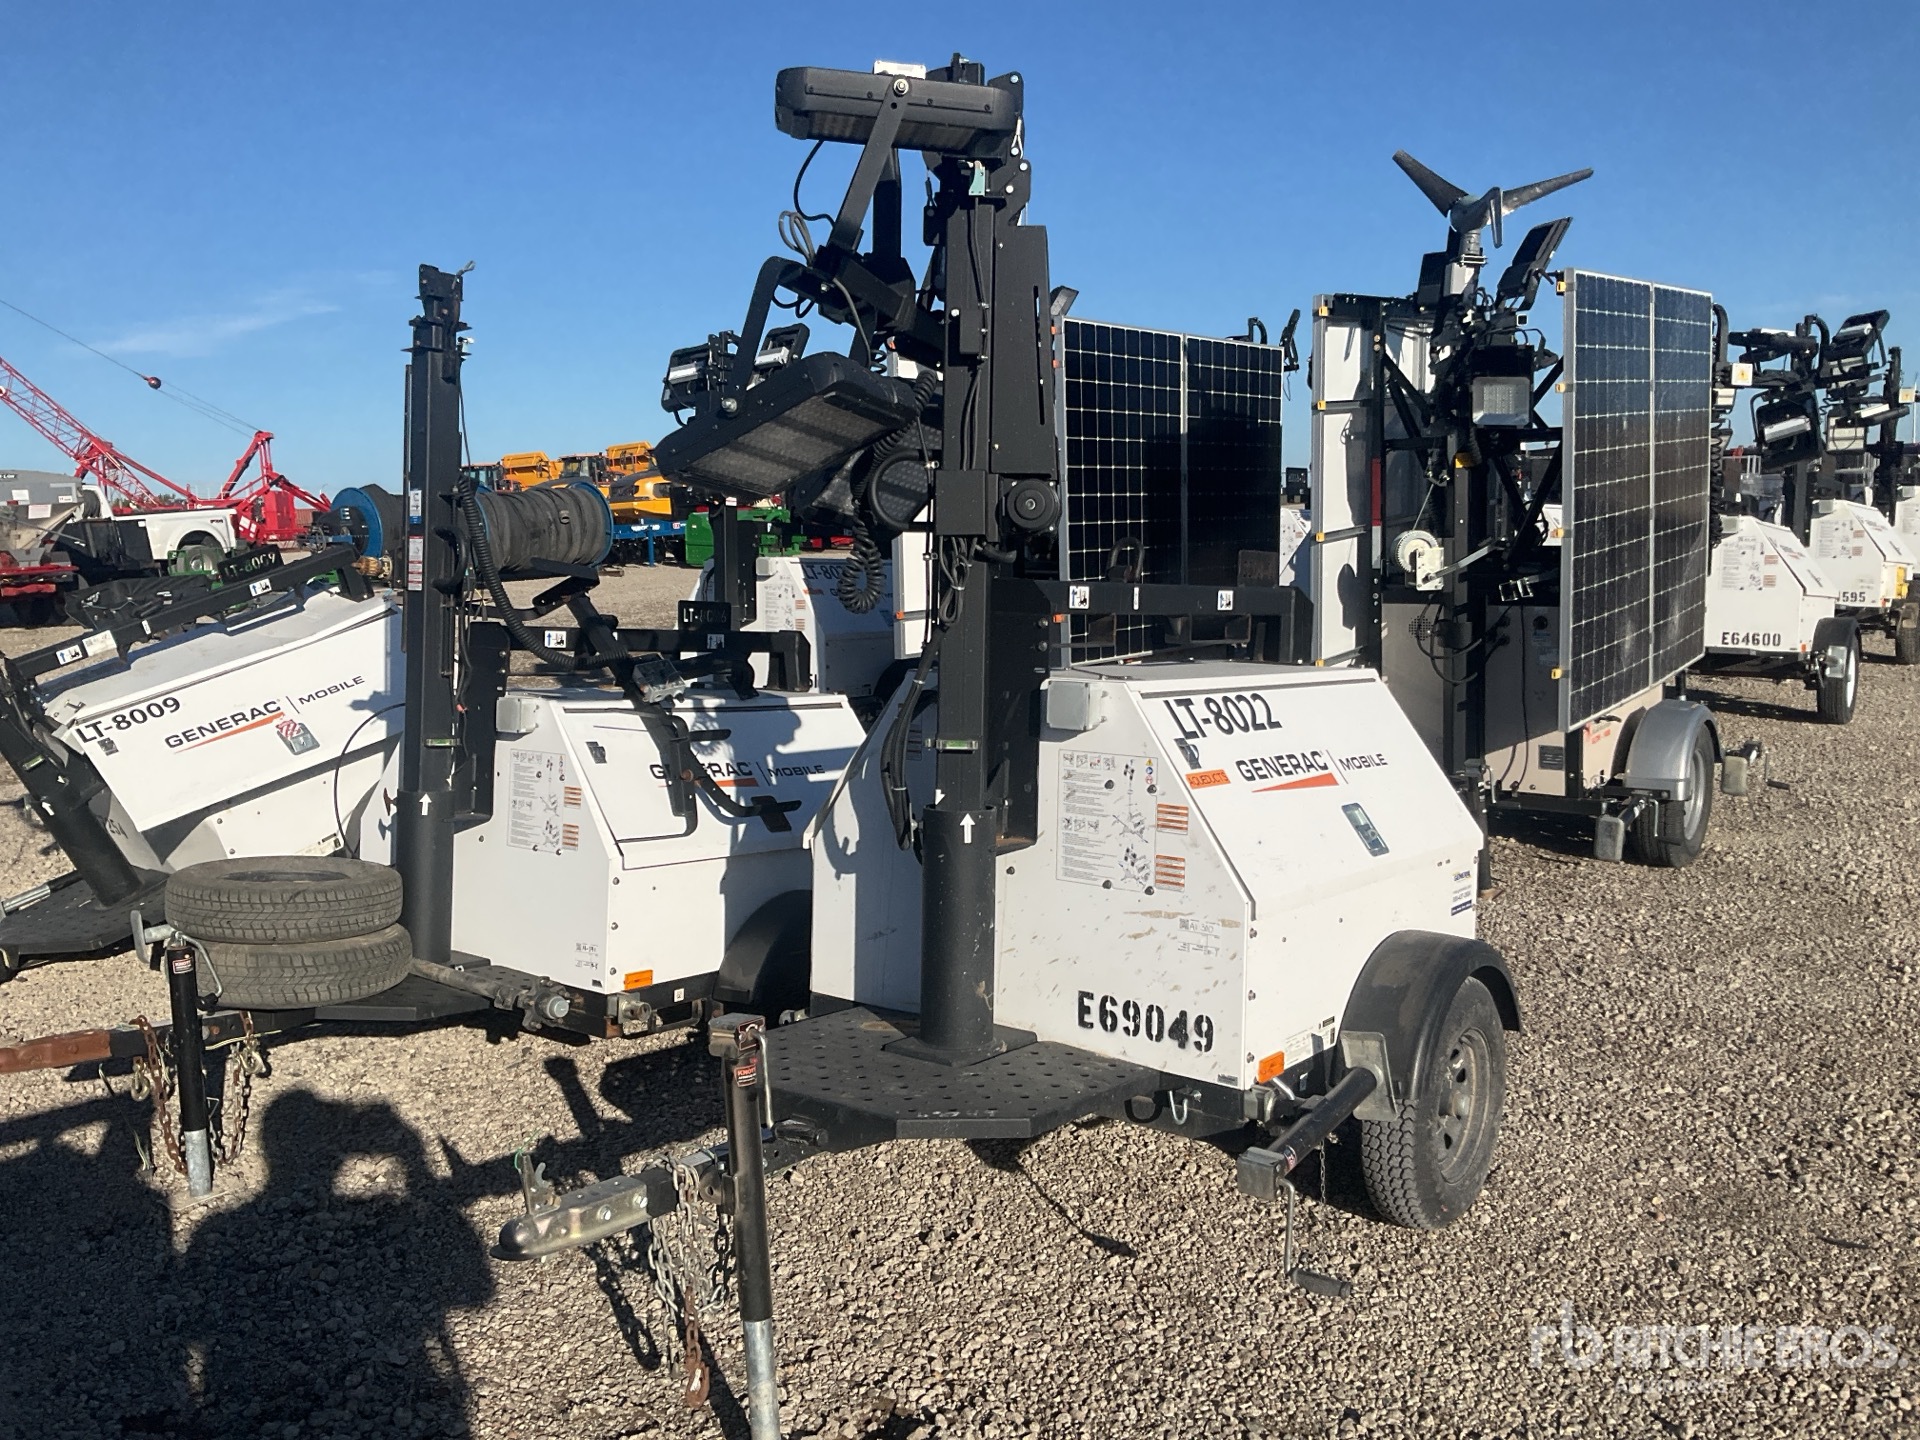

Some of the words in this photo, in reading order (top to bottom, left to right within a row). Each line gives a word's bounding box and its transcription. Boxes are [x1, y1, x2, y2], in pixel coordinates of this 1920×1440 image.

[1839, 591, 1866, 603] 595
[1721, 632, 1781, 647] E64600
[75, 697, 180, 743] LT-8009
[164, 700, 281, 748] GENERAC
[298, 676, 365, 705] MOBILE
[1163, 693, 1282, 740] LT-8022
[768, 765, 825, 777] MOBILE
[1236, 750, 1329, 782] GENERAC
[1338, 753, 1388, 771] MOBILE
[1078, 990, 1214, 1052] E69049
